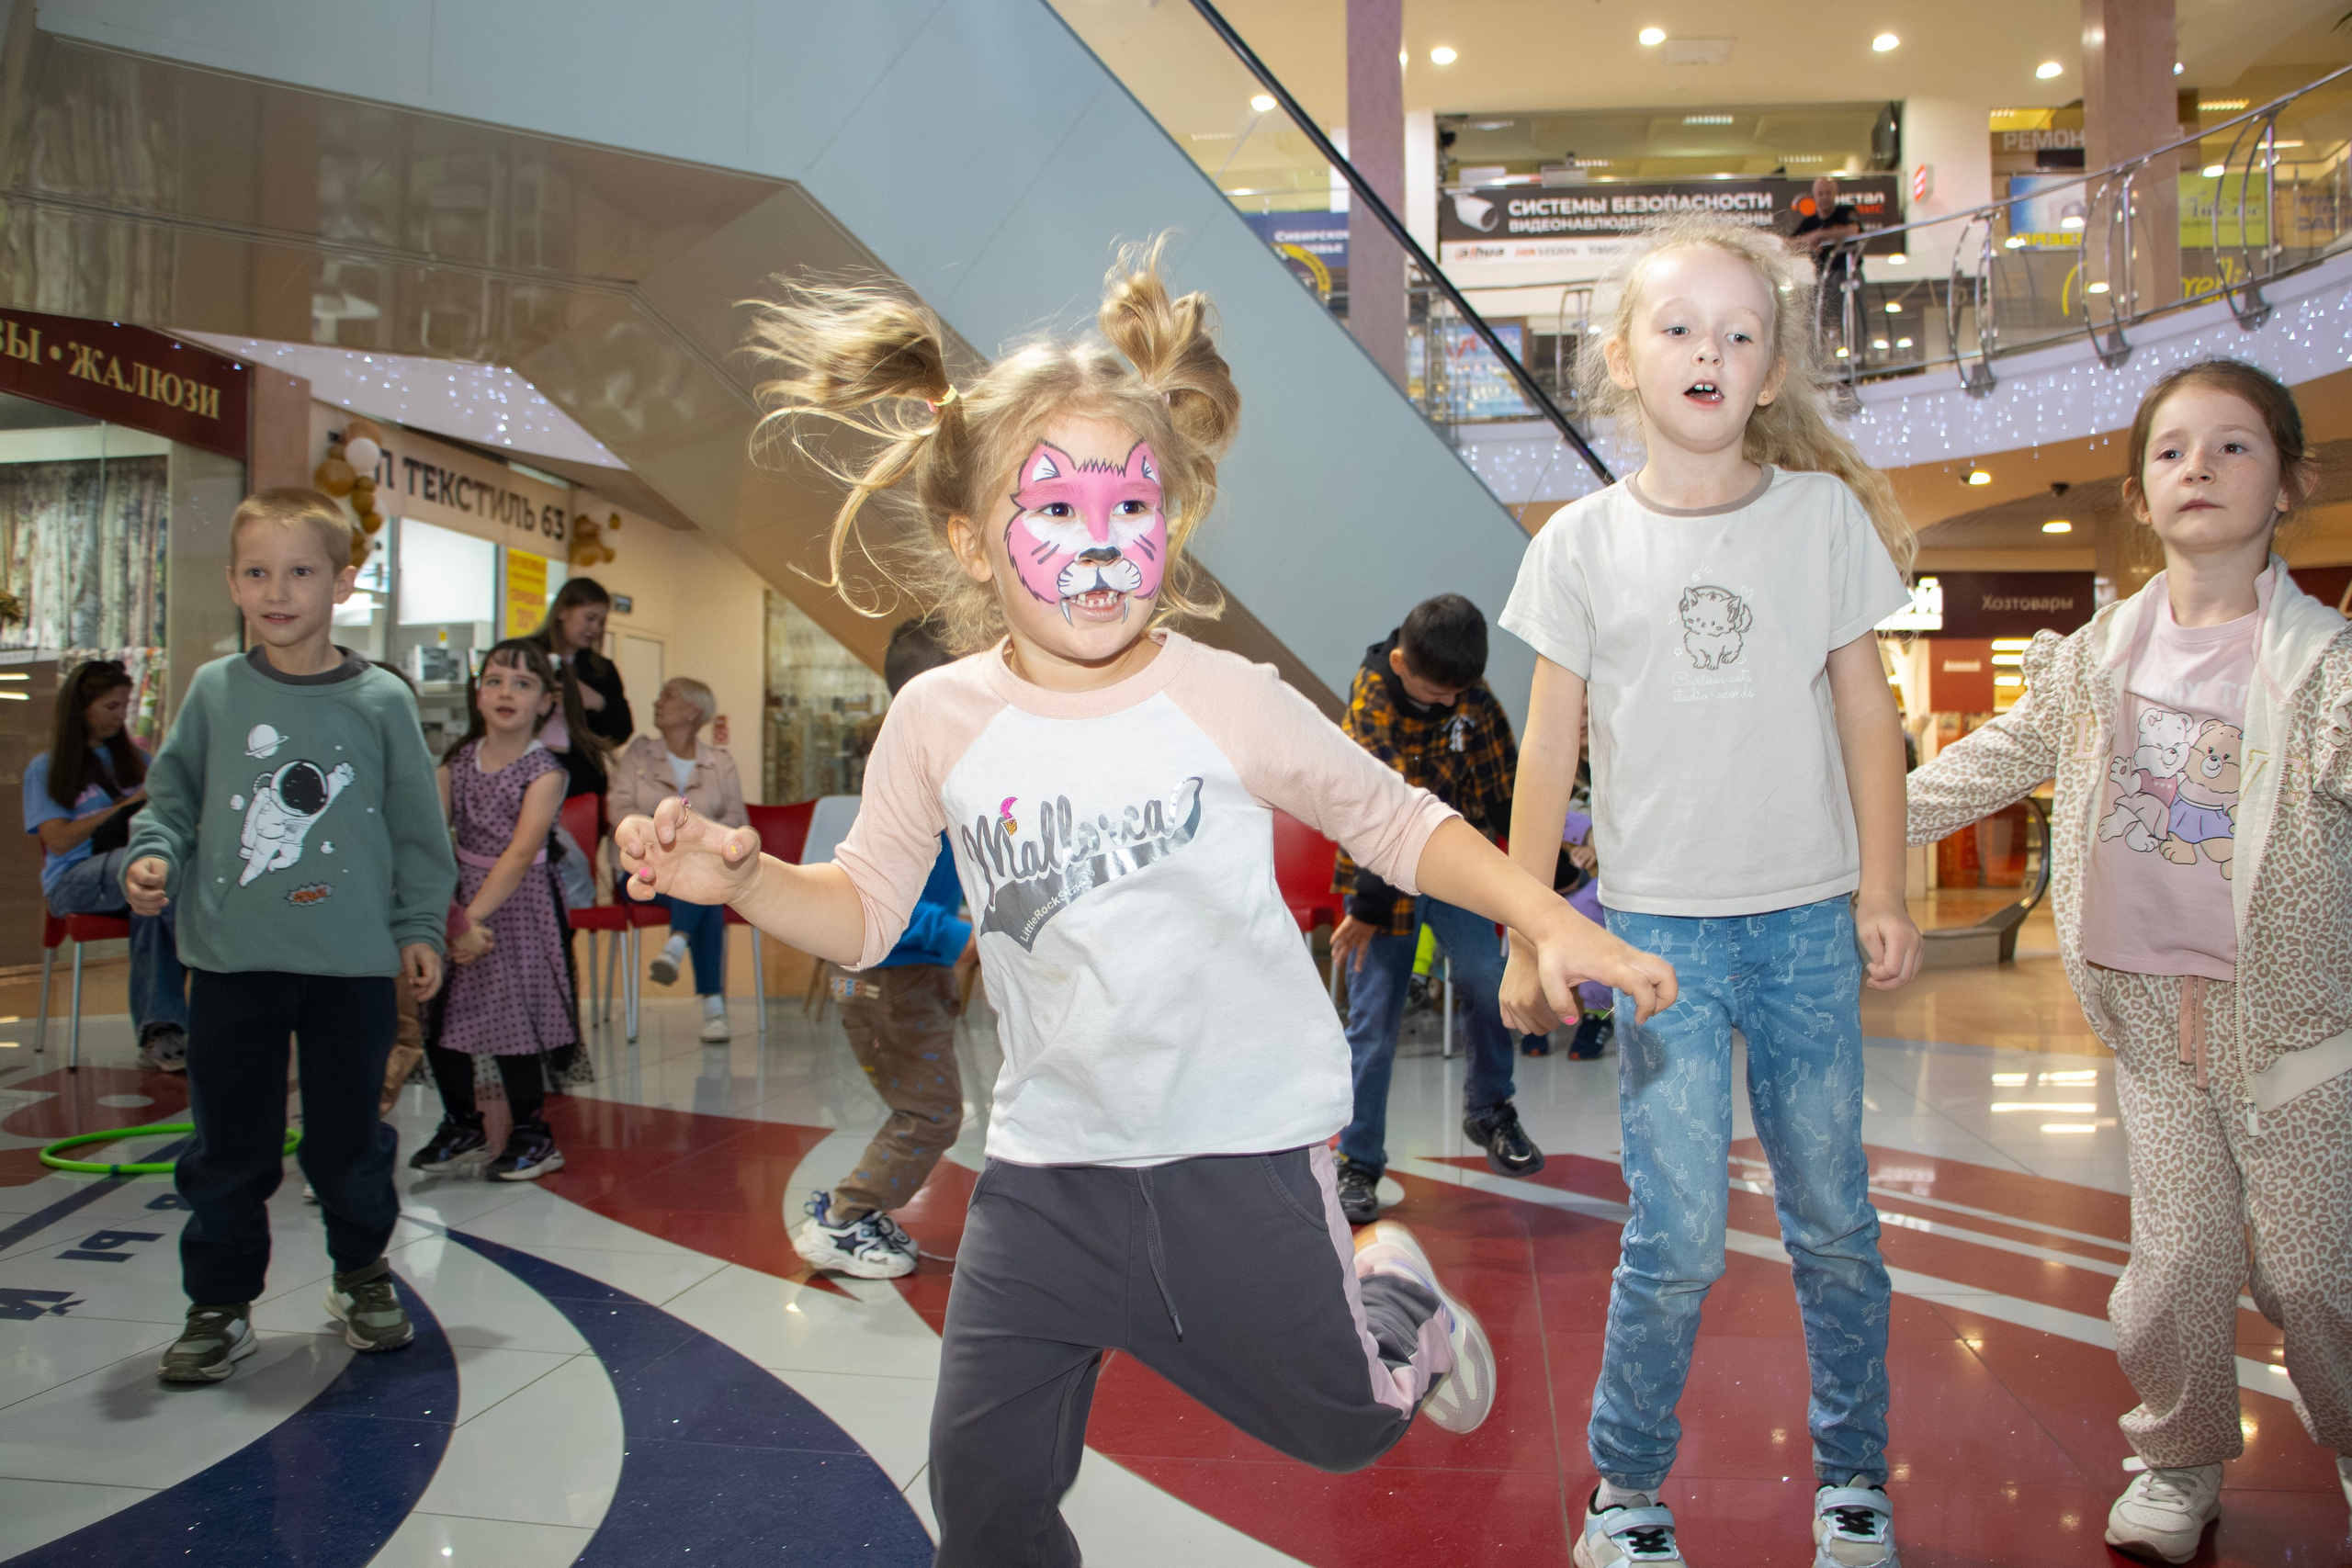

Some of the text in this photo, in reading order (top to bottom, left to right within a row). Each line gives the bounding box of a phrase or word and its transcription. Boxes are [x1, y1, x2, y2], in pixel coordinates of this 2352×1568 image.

[2003, 129, 2086, 152] РЕМОН
[1508, 192, 1773, 218] СИСТЕМЫ БЕЗОПАСНОСТИ
[0, 321, 220, 420] Ы ЖАЛЮЗИ
[401, 457, 536, 532] ТЕКСТИЛЬ
[540, 504, 565, 541] 63
[1982, 594, 2074, 614] Хозтовары
[1672, 670, 1753, 687] Curious cats
[1673, 682, 1755, 703] studio records
[962, 795, 1163, 906] Mallorca
